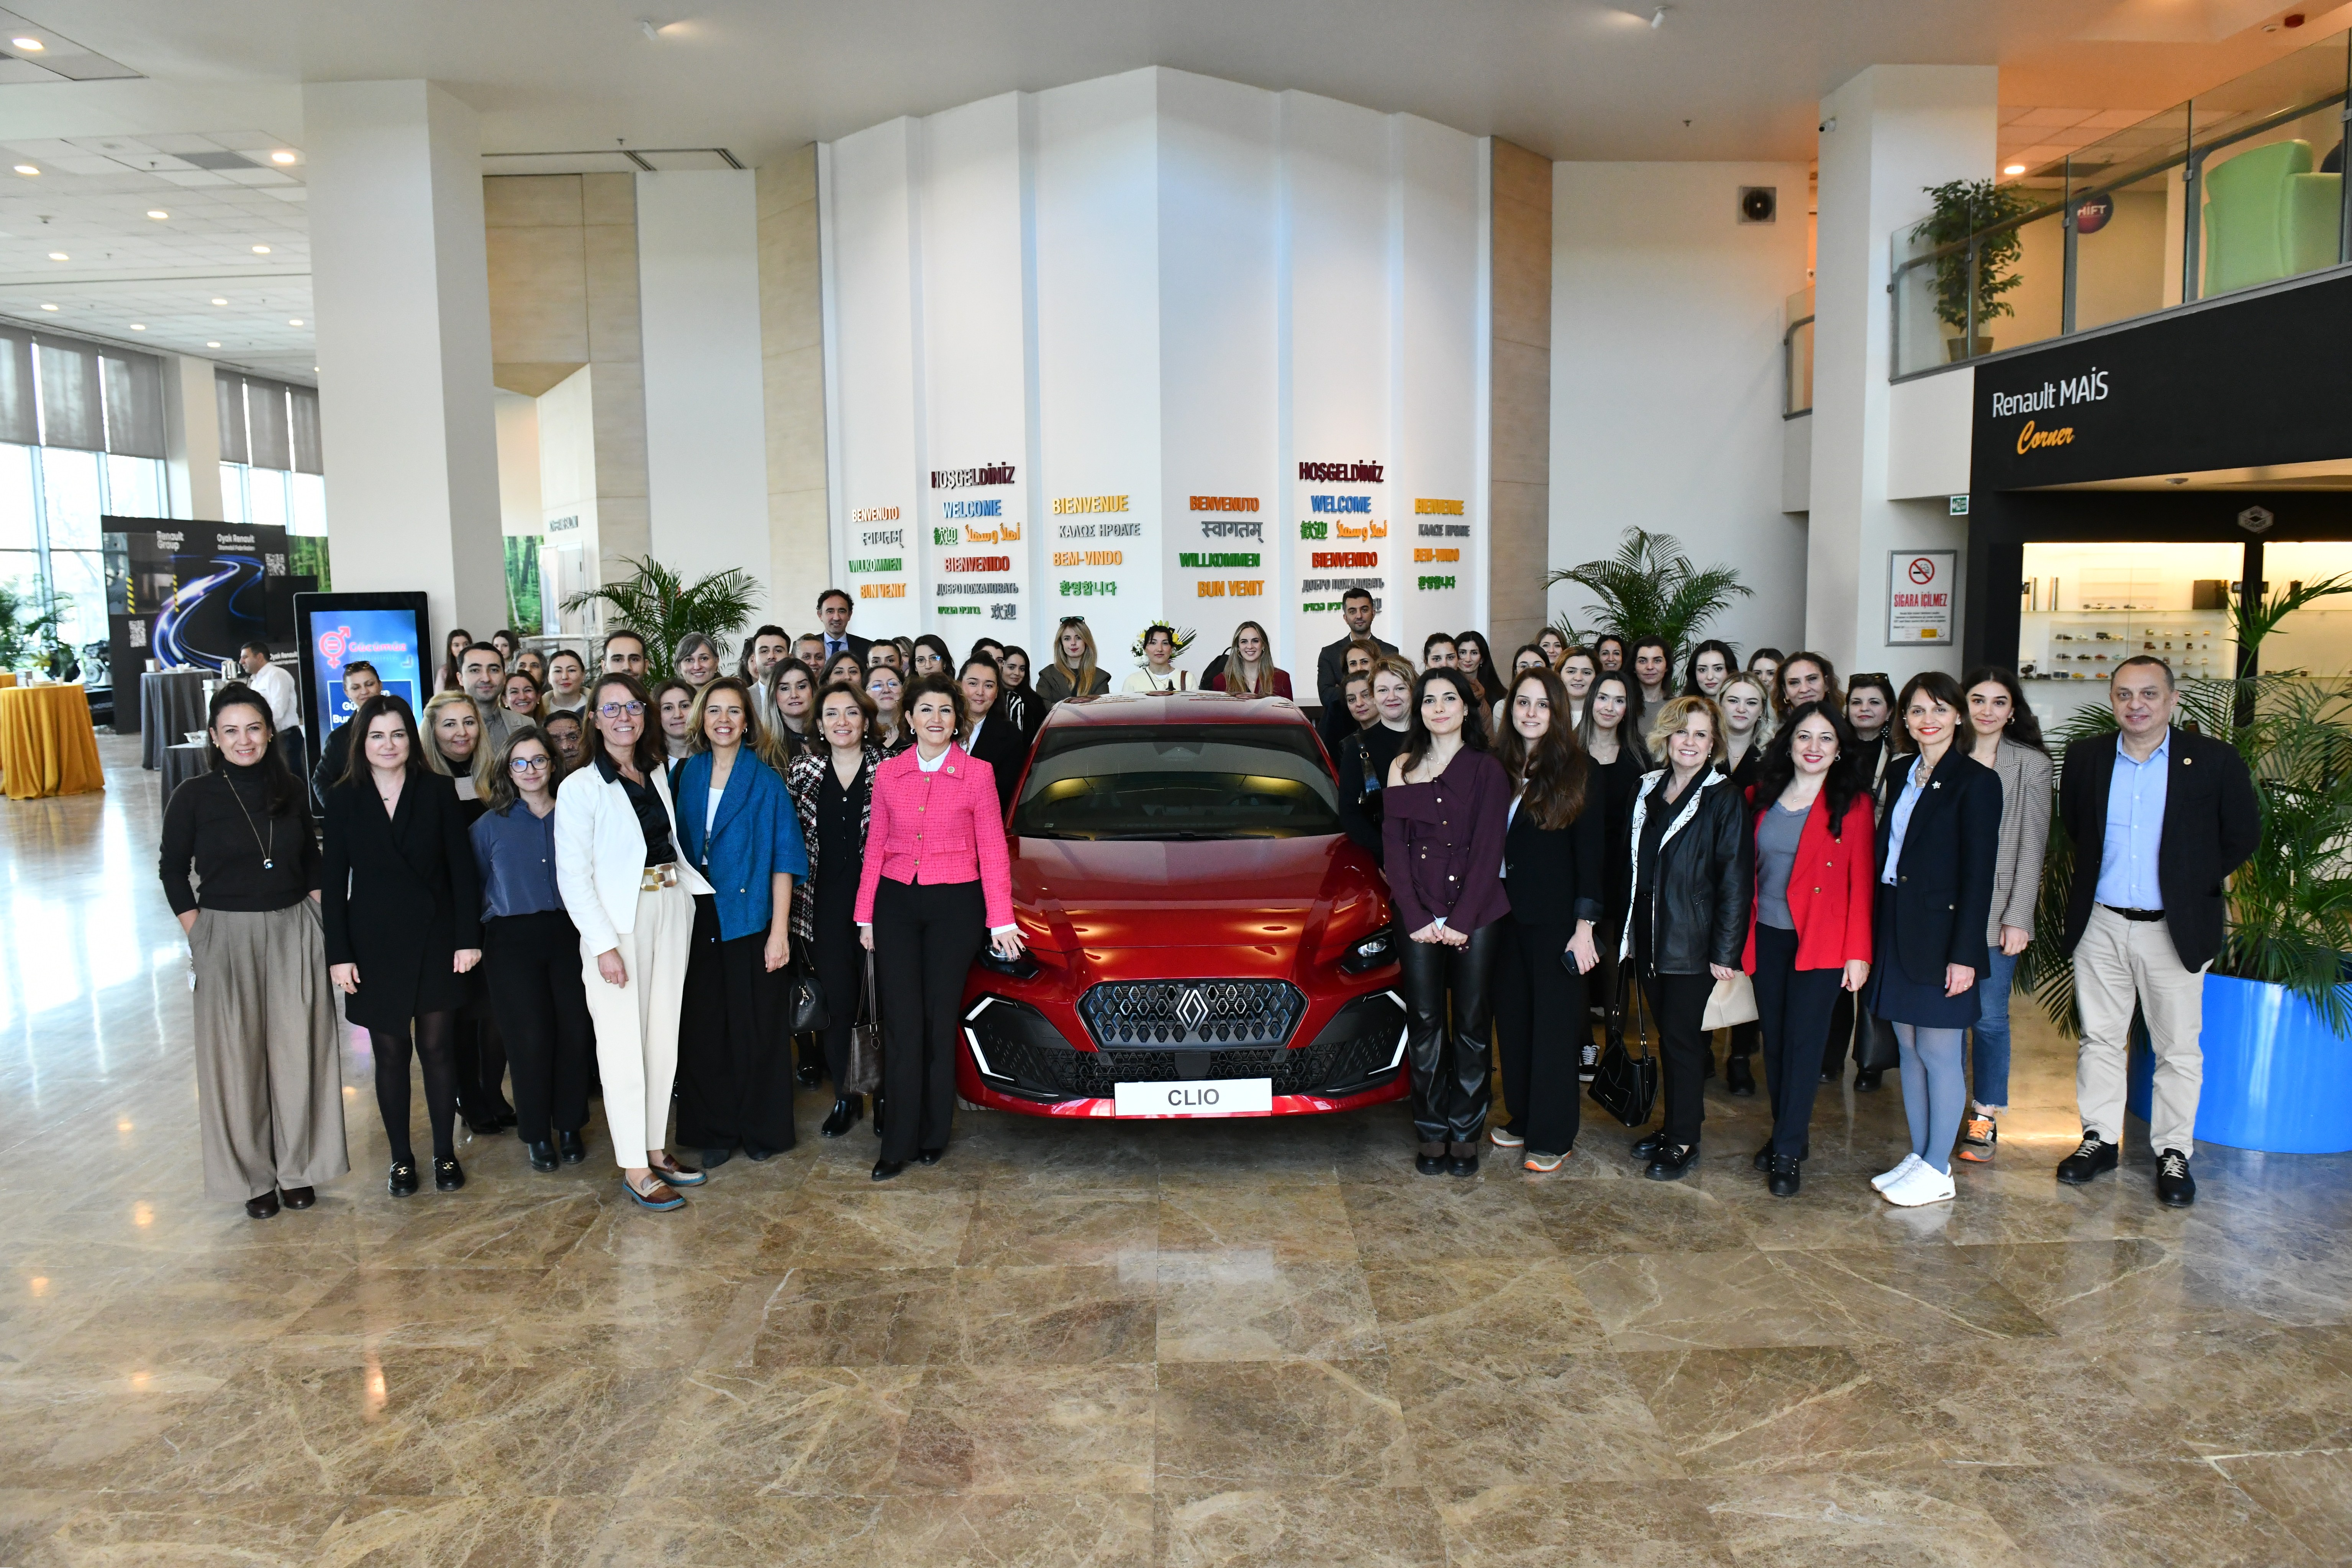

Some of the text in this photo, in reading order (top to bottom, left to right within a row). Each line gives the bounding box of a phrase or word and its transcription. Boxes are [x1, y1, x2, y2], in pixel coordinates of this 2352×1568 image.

[2077, 205, 2107, 216] HIFT
[1993, 382, 2056, 418] Renault
[2016, 420, 2075, 455] Corner
[931, 461, 1015, 489] HOŞGELDİNİZ
[1299, 460, 1384, 483] HOŞGELDİNİZ
[942, 499, 1002, 518] WELCOME
[1053, 495, 1128, 514] BIENVENUE
[1190, 496, 1259, 511] BENVENUTO
[1311, 495, 1372, 512] WELCOME
[852, 506, 899, 522] BENVENUTO
[157, 531, 184, 541] Renault
[217, 533, 255, 544] Oyak Renault
[1201, 521, 1264, 543] स्वागतम्
[157, 539, 180, 552] Group
[849, 558, 901, 572] WILLKOMMEN
[944, 556, 1010, 572] BIENVENIDO
[1053, 550, 1122, 566] BEM-VINDO
[1179, 553, 1260, 567] WILLKOMMEN
[1312, 552, 1377, 567] BIENVENIDO
[860, 583, 906, 598] BUN VENIT
[936, 583, 1019, 596] ДОБРО ПОЖАЛОВАТЬ
[1059, 580, 1117, 596] 환영합니다
[1198, 580, 1264, 597] BUN VENIT
[1302, 579, 1331, 592] ДОБРО
[1894, 591, 1947, 608] SİGARA İÇİLMEZ
[990, 603, 1016, 620] 欢迎
[348, 641, 407, 652] Gücümüz
[1168, 1089, 1219, 1106] CLIO
